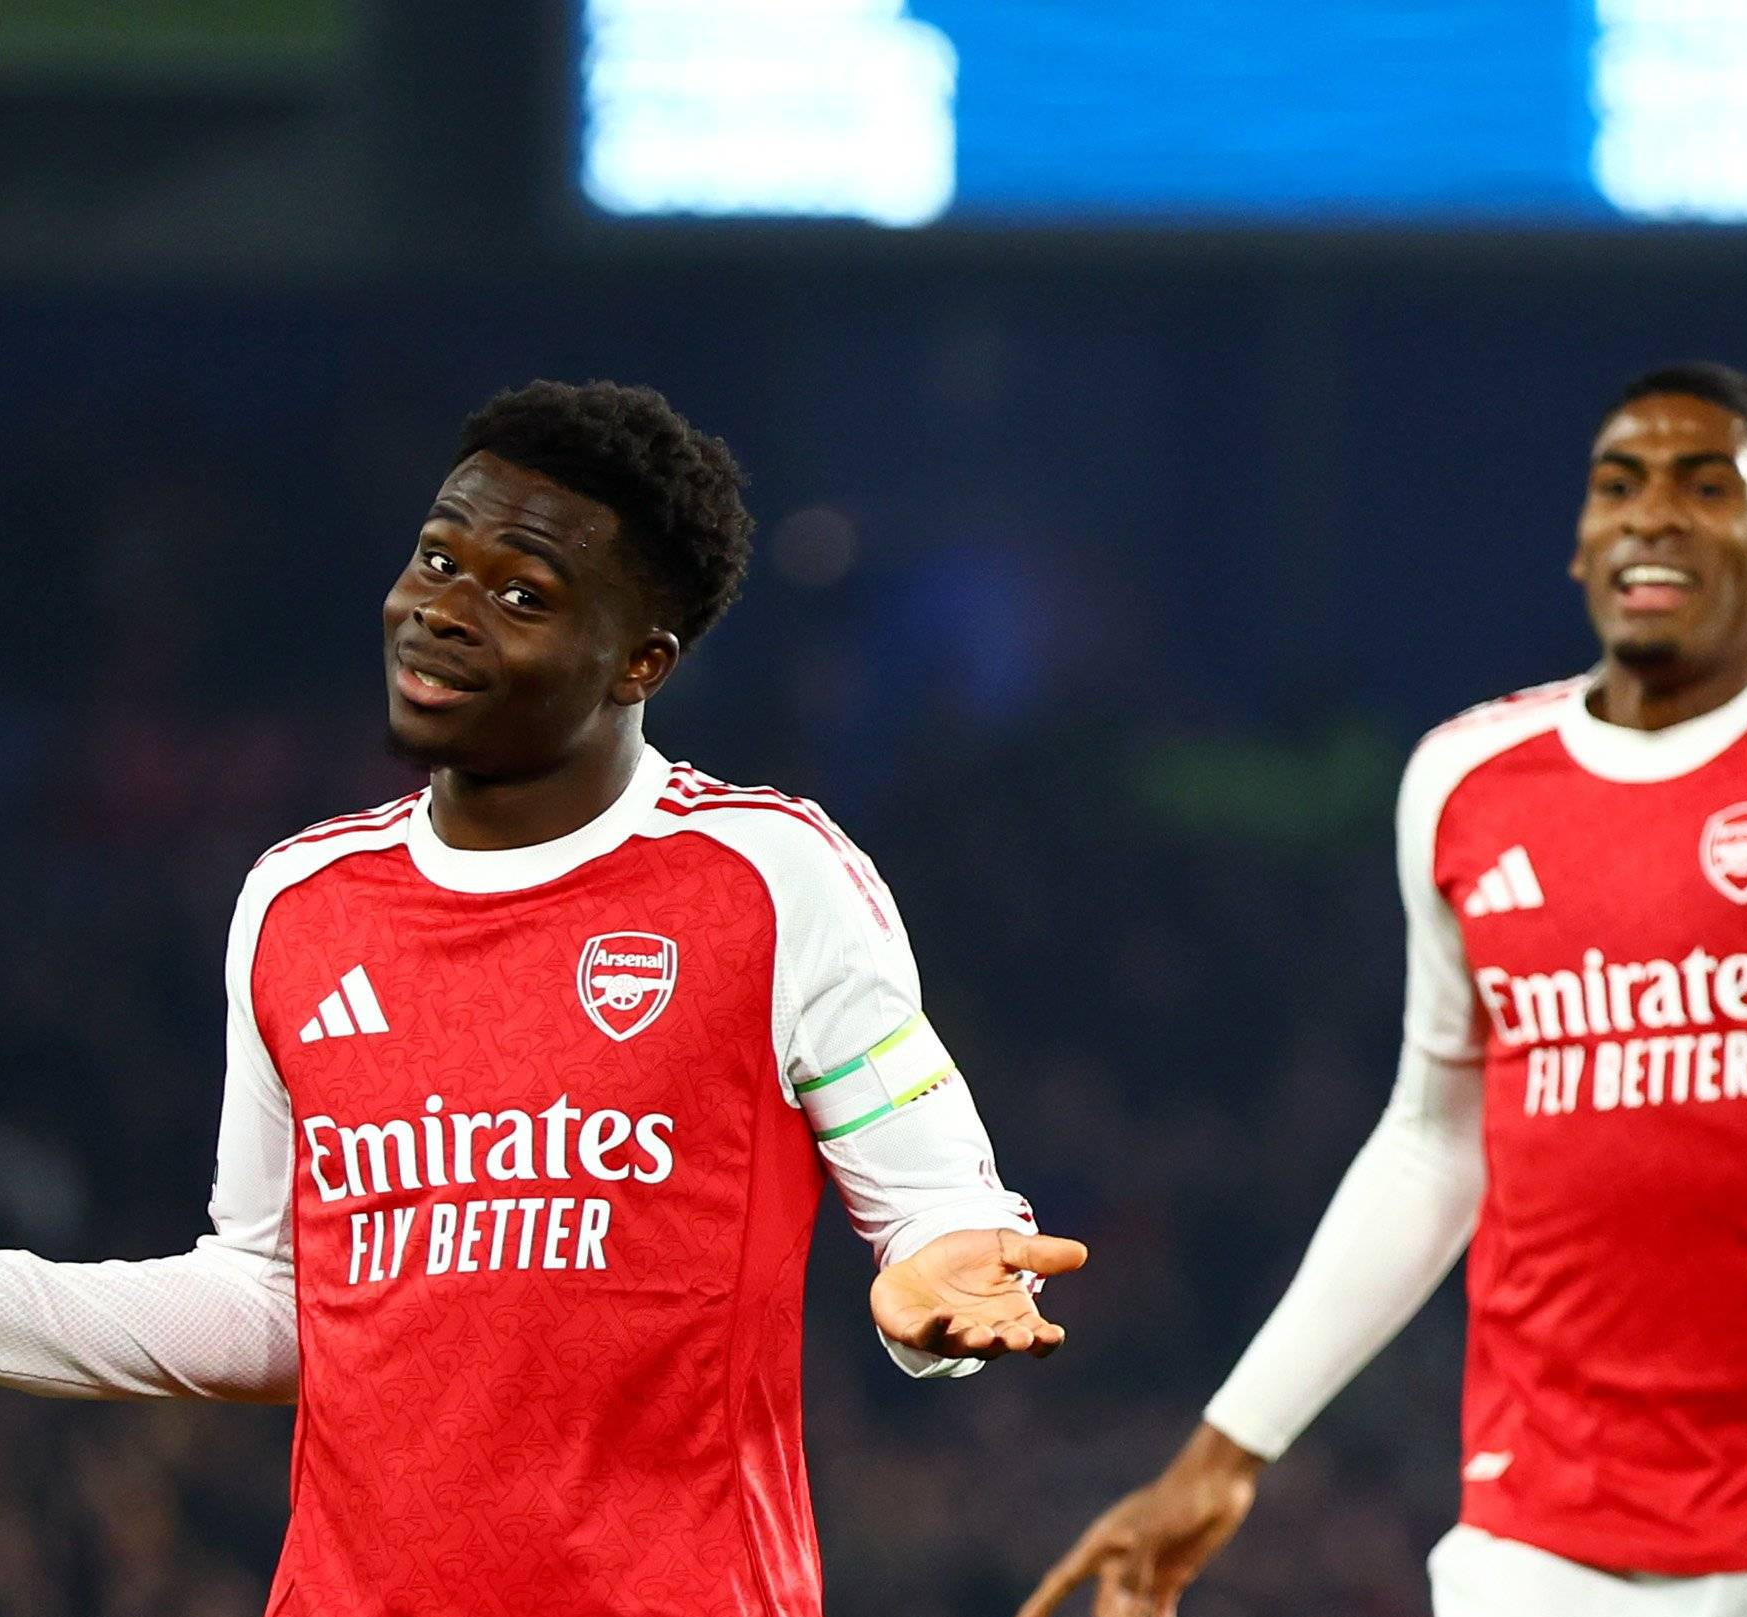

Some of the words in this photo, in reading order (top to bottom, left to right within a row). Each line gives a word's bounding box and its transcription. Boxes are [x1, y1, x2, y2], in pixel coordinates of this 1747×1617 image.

[593, 948, 663, 969] Arsenal
[1524, 1043, 1586, 1118] FLY
[302, 1092, 674, 1203] Emirates
[348, 1206, 415, 1285] FLY
[425, 1197, 611, 1275] BETTER
